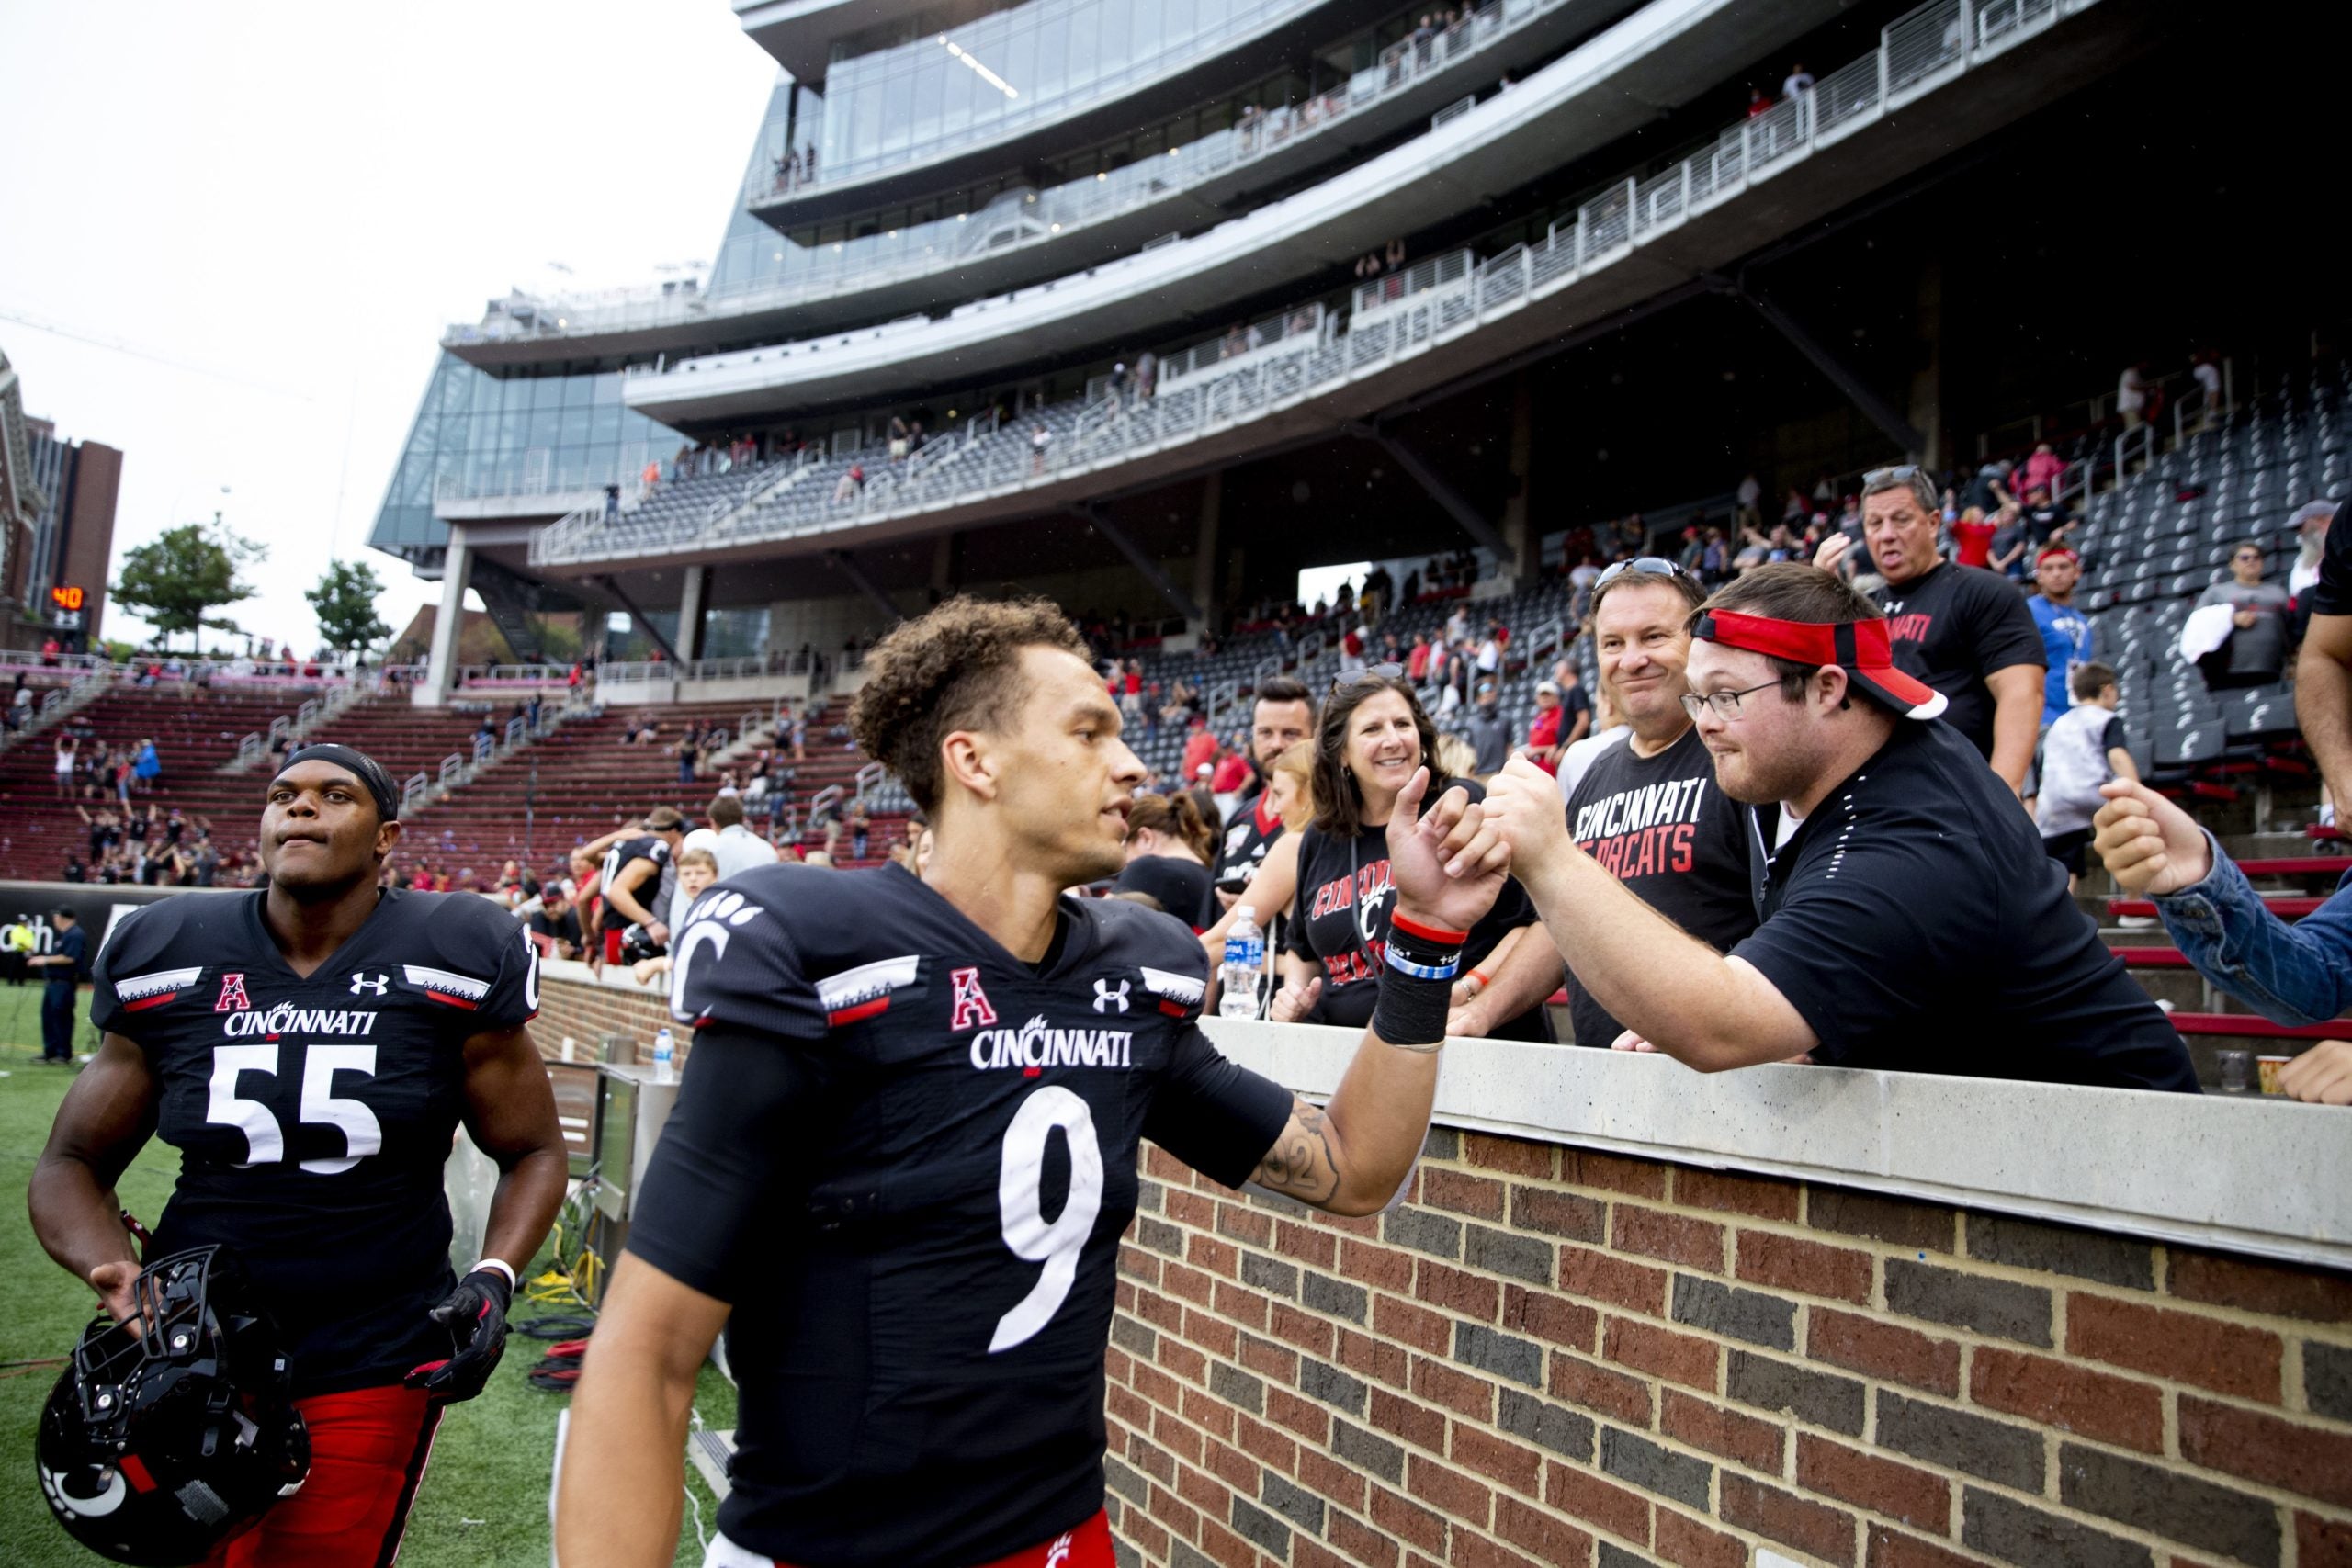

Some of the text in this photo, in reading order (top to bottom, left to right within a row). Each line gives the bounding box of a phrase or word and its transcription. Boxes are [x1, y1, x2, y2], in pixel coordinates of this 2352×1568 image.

[52, 587, 83, 610] 40
[1573, 776, 1707, 844] CINCINNATI
[1579, 824, 1695, 880] ARCATS
[223, 1001, 378, 1038] CINCINNATI
[970, 1014, 1133, 1070] CINCINNATI
[205, 1044, 382, 1174] 55
[987, 1084, 1104, 1353] 9
